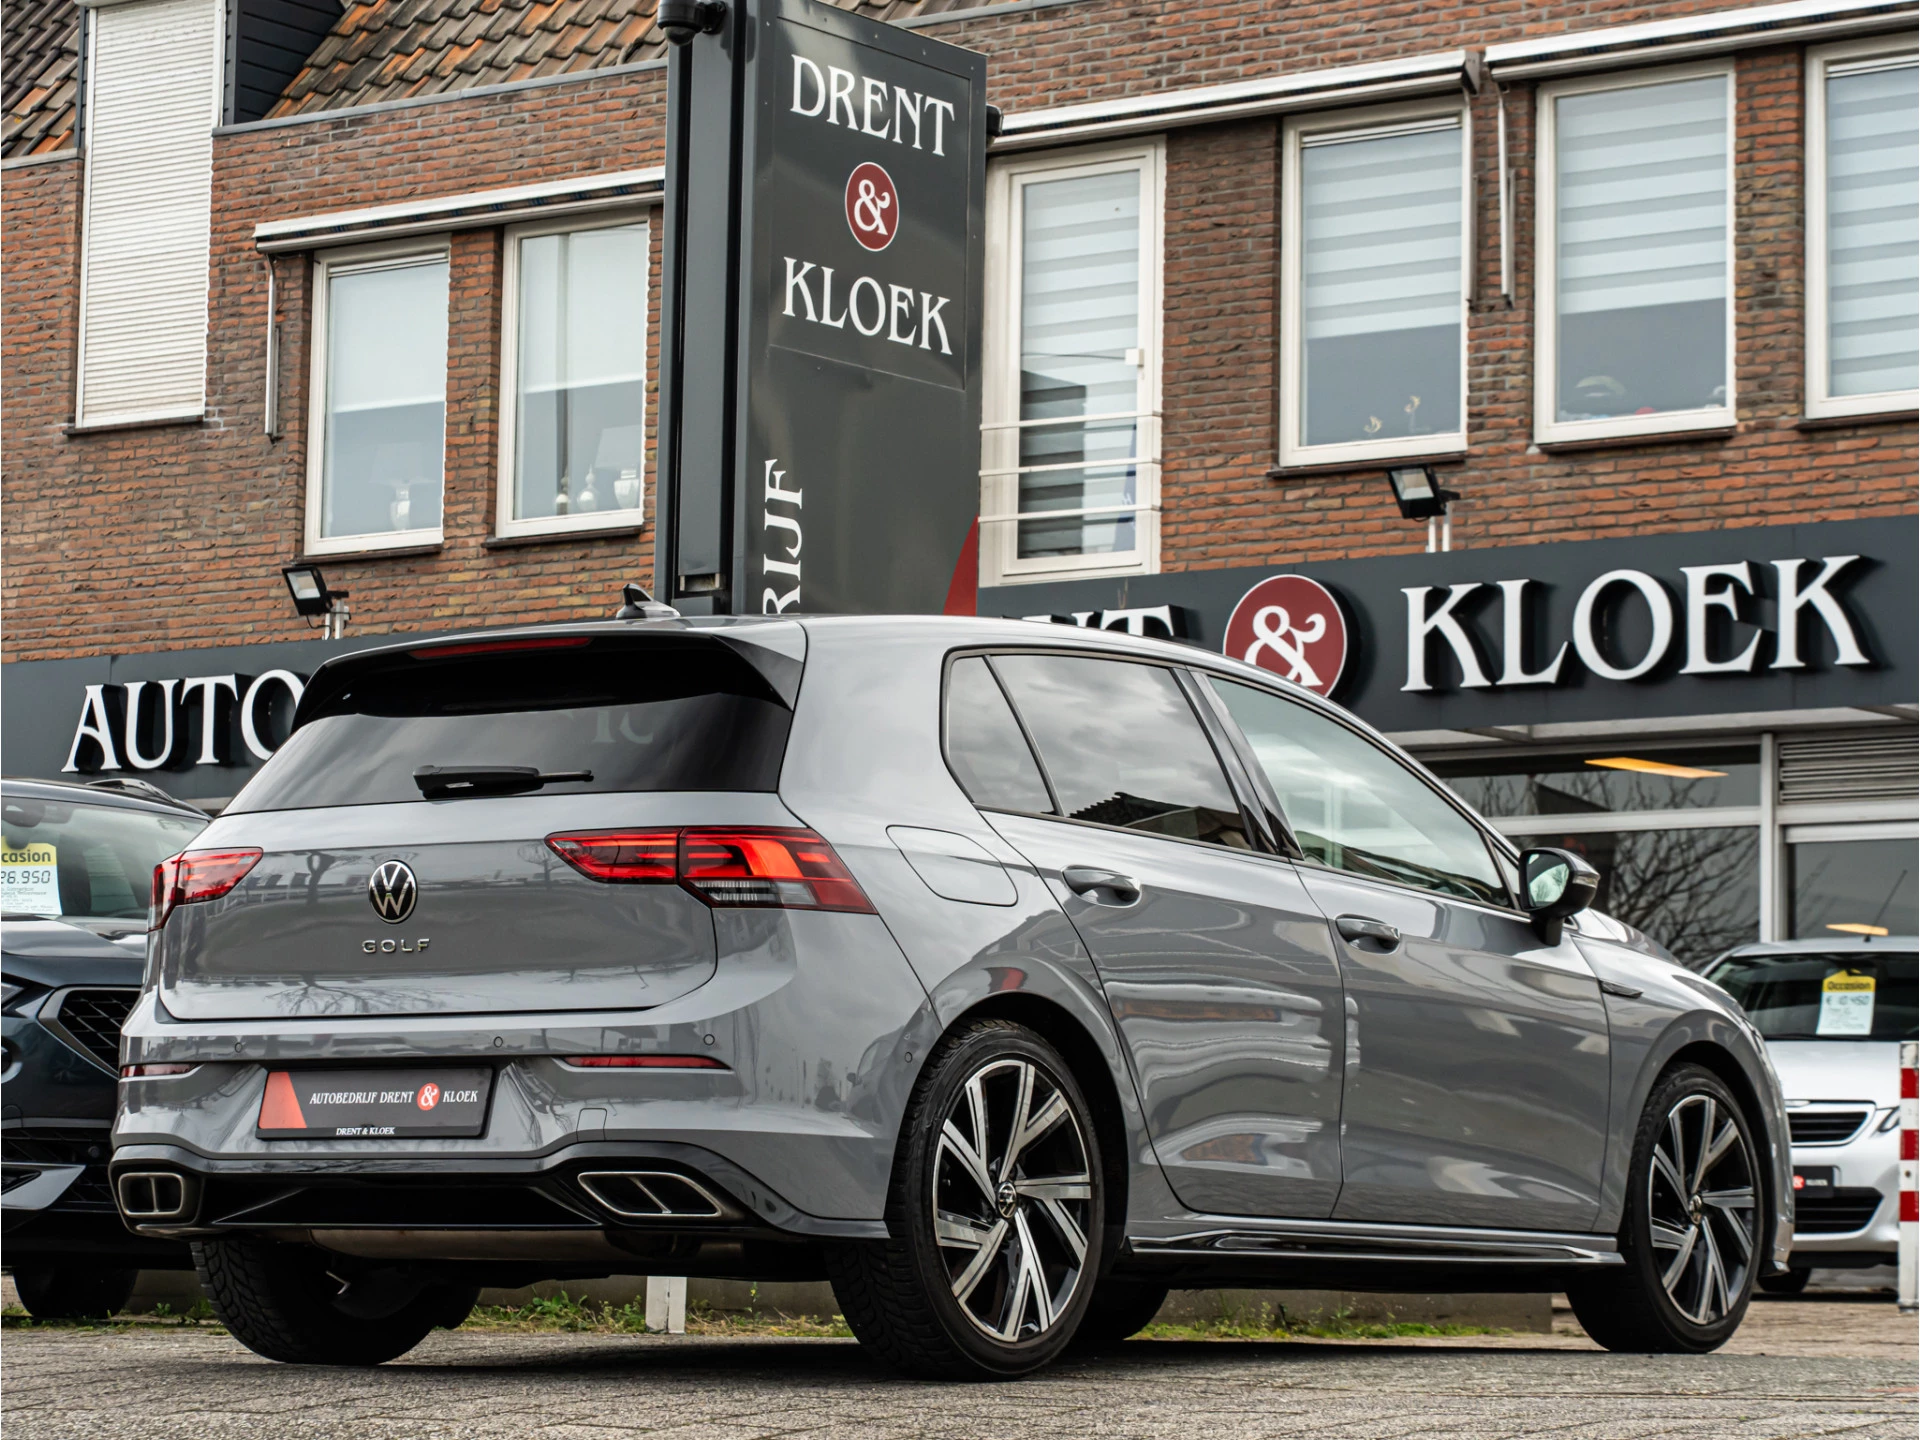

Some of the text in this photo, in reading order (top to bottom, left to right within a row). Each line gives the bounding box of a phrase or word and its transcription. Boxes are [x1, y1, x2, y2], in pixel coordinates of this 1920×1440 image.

[790, 54, 954, 157] DRENT
[853, 179, 891, 235] &
[783, 257, 953, 355] KLOEK
[1244, 555, 1870, 691] & KLOEK
[61, 669, 306, 773] AUTO
[362, 938, 430, 953] GOLF
[309, 1085, 478, 1107] AUTOBEDRIJF DRENT & KLOEK
[336, 1127, 361, 1136] DRENT
[369, 1127, 395, 1135] KLOEK
